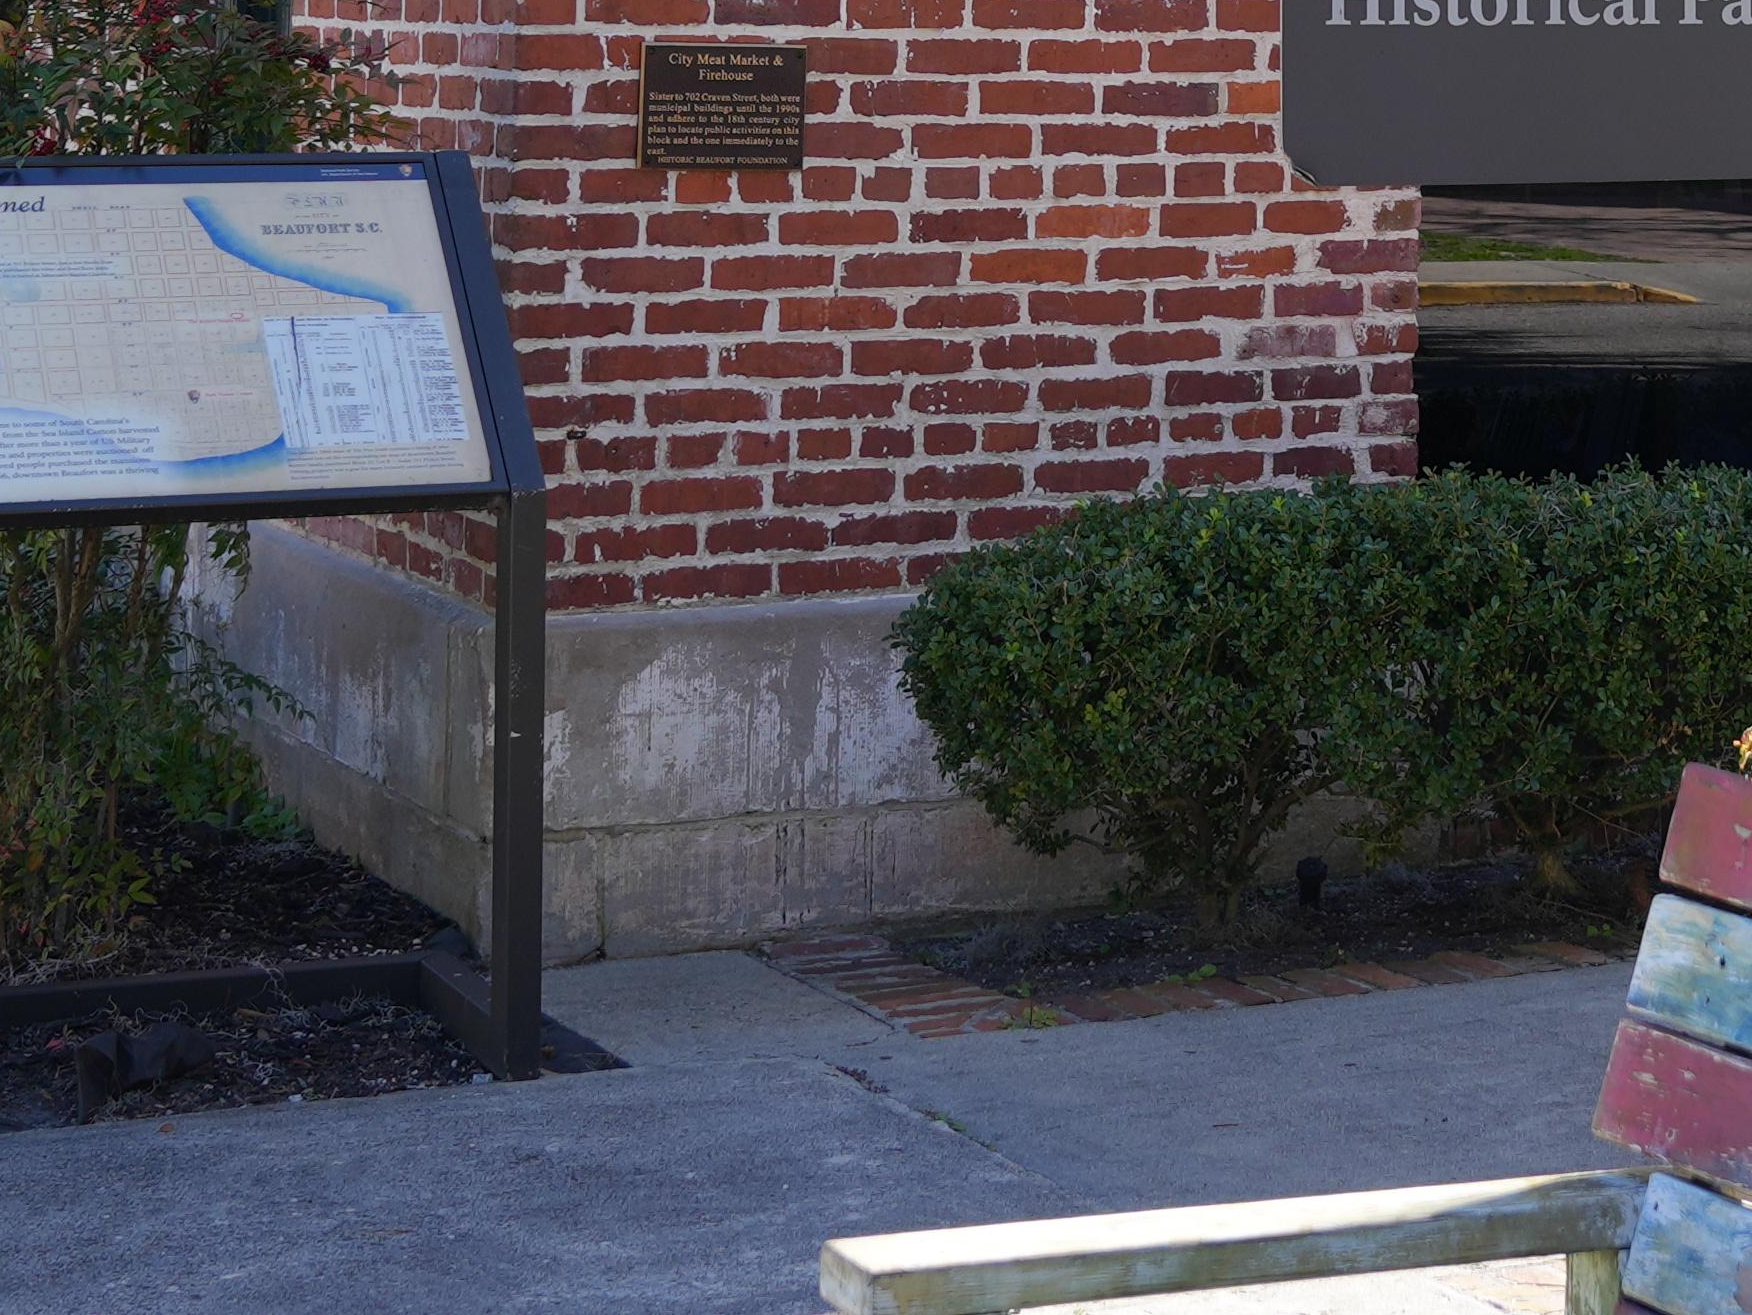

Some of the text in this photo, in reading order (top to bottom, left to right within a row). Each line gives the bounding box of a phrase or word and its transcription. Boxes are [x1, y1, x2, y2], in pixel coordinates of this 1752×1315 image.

[669, 53, 784, 67] City Meat Market &
[699, 69, 754, 80] Firehouse
[261, 223, 351, 235] BEAUFORT
